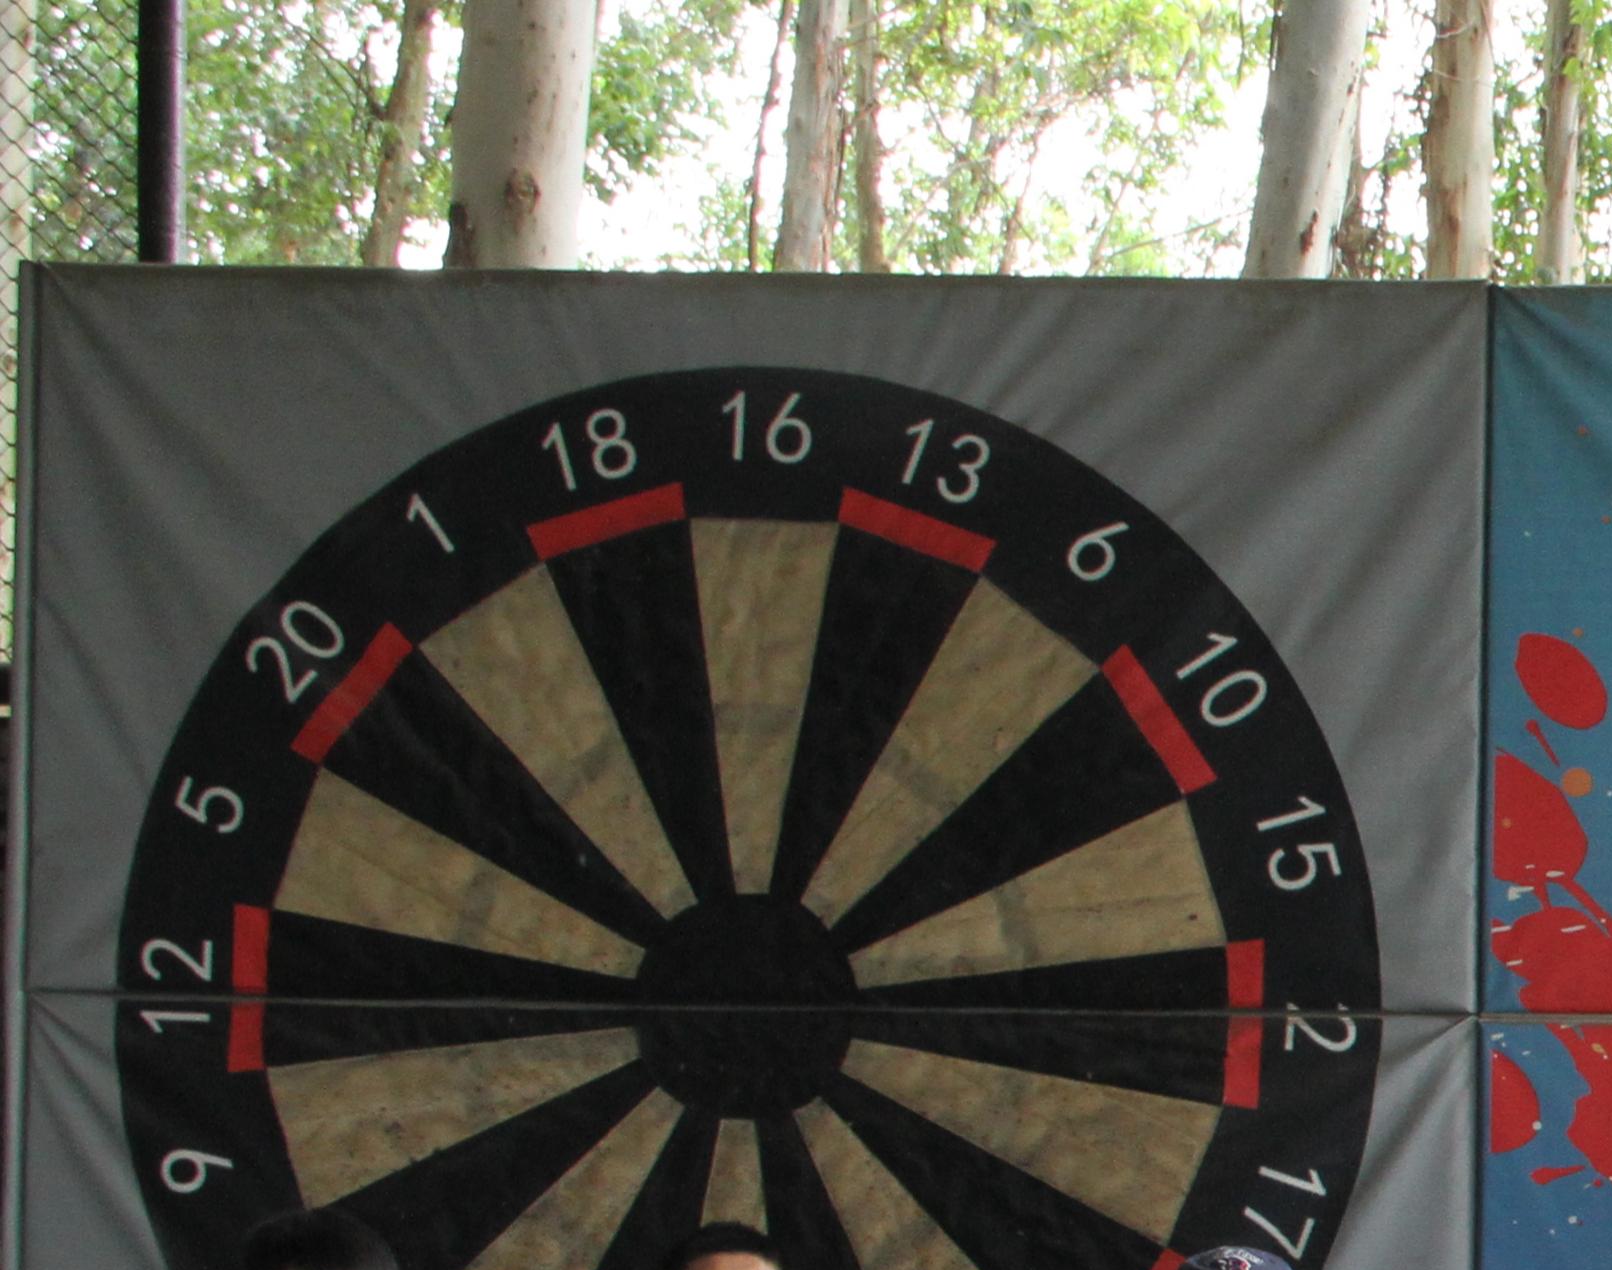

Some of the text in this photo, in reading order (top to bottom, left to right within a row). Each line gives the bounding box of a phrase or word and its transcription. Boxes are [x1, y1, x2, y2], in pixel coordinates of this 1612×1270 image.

[543, 408, 636, 490] 18
[723, 392, 811, 463] 16
[902, 419, 990, 503] 13
[407, 496, 454, 552] 1
[1067, 522, 1128, 582] 6
[247, 601, 342, 702] 20
[1175, 632, 1268, 727] 10
[176, 776, 242, 833] 5
[1256, 795, 1342, 891] 15
[139, 937, 213, 1034] 12
[1284, 1002, 1358, 1053] 2
[160, 1149, 234, 1195] 9
[1243, 1165, 1327, 1261] 17
